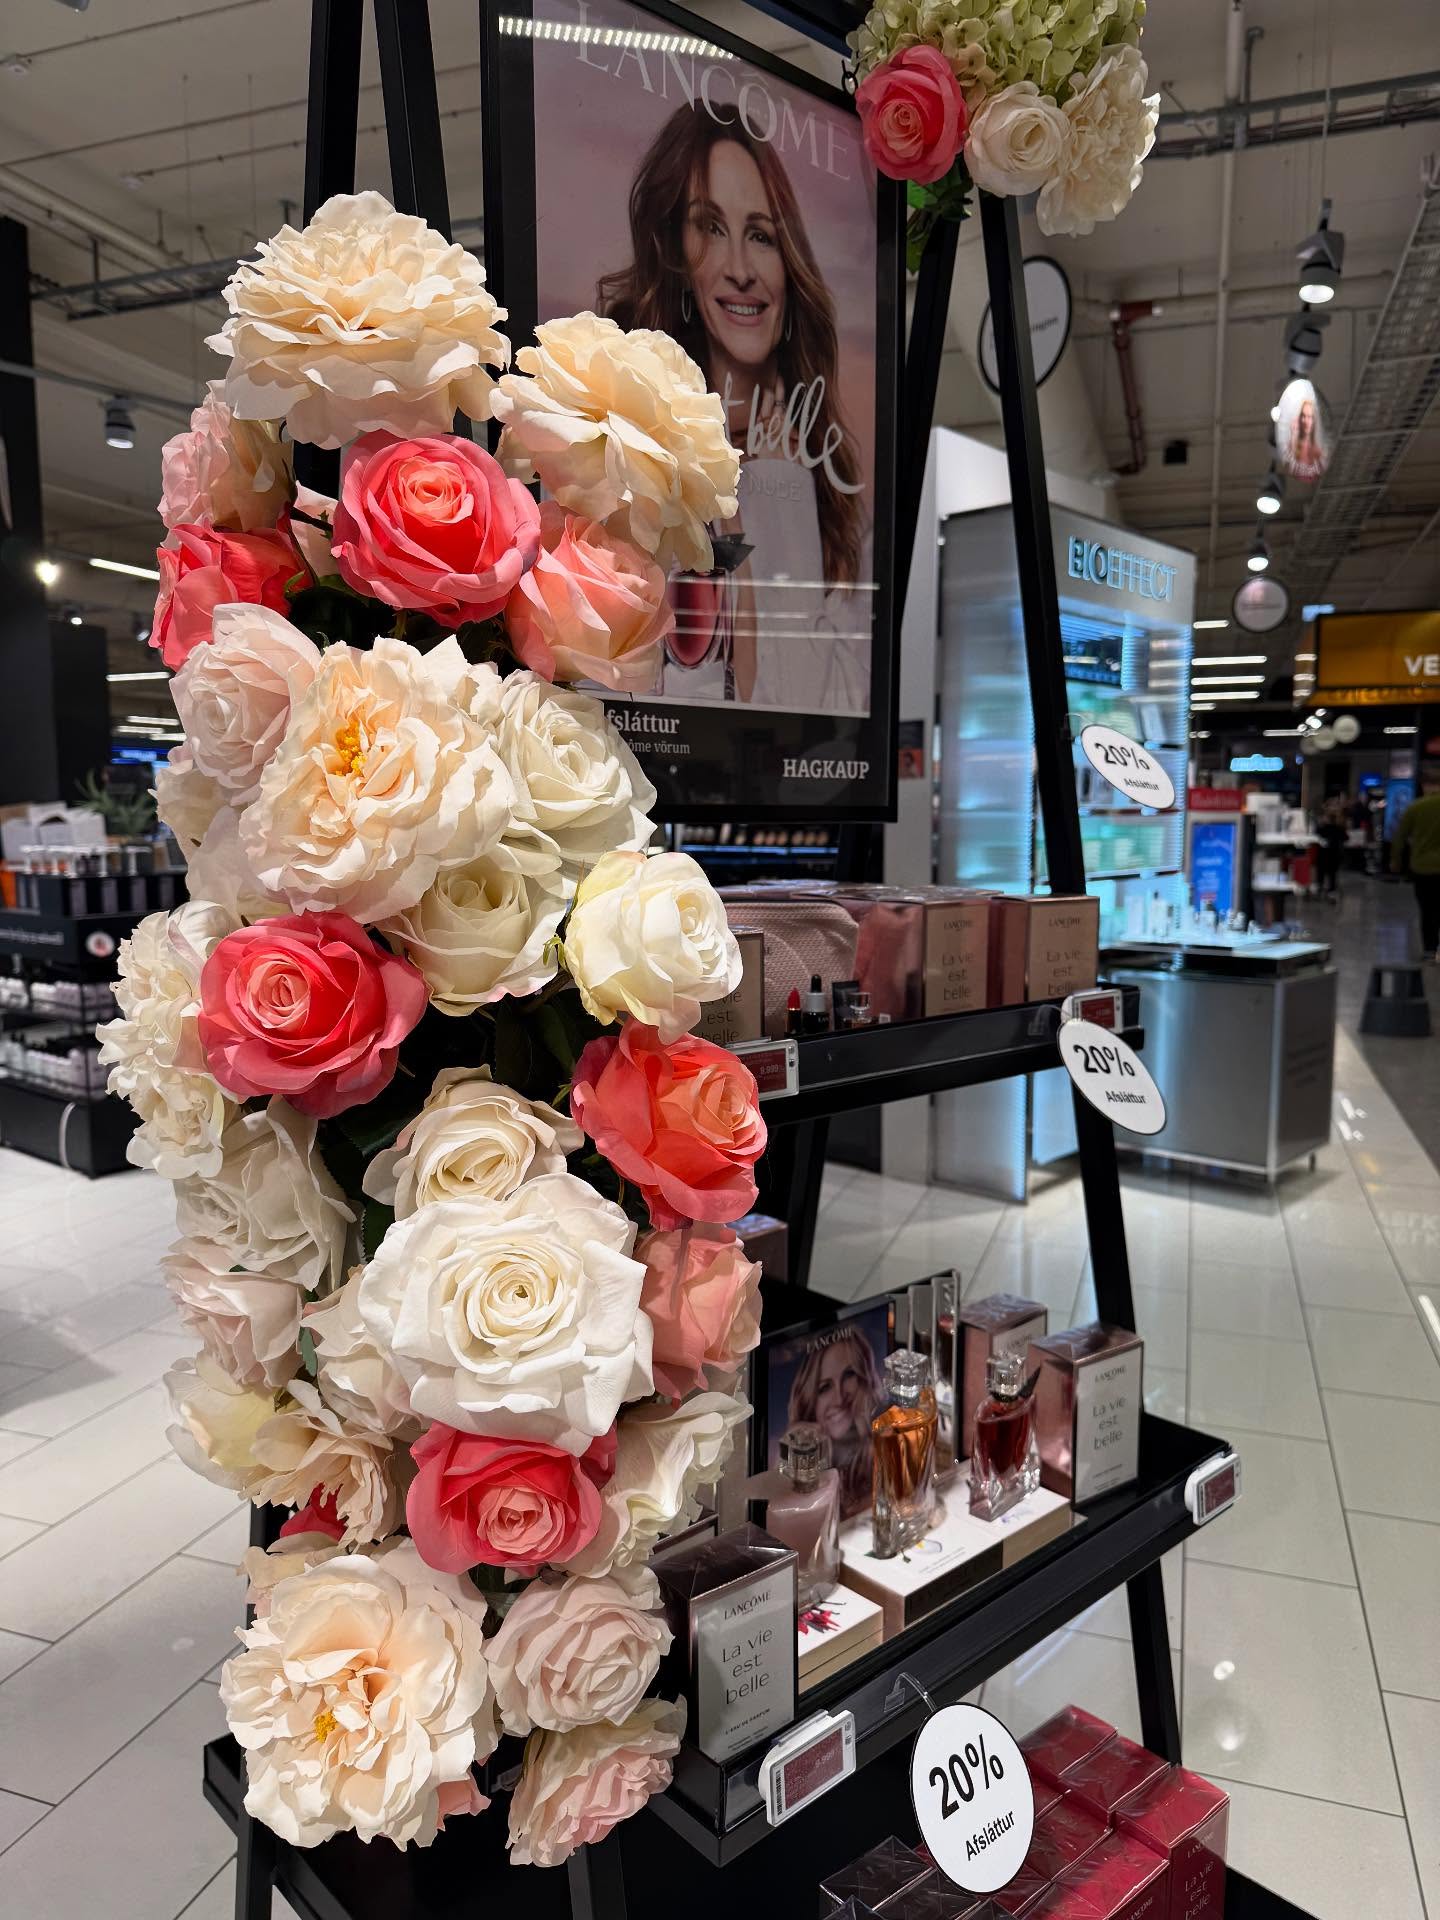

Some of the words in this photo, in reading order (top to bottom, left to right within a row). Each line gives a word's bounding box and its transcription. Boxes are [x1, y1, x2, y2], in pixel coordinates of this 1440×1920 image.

[576, 0, 851, 181] LANCÔME
[747, 375, 866, 494] belle
[1068, 535, 1178, 603] BIOEFFECT
[606, 709, 681, 735] fsláttur
[653, 739, 691, 755] vörum
[1094, 742, 1151, 771] 20%
[782, 758, 870, 780] HAGKAUP
[1123, 778, 1160, 791] Afsláttur
[707, 1010, 734, 1025] est
[1073, 1044, 1136, 1077] 20%
[1105, 1090, 1147, 1104] Afsláttur
[1091, 1402, 1107, 1418] La
[1108, 1396, 1126, 1411] vie
[1098, 1414, 1118, 1430] est
[1093, 1430, 1123, 1451] belle
[724, 1590, 772, 1621] LANCÔME
[721, 1644, 742, 1664] La
[747, 1628, 774, 1650] vie
[732, 1652, 763, 1678] est
[725, 1672, 770, 1705] belle
[928, 1733, 1005, 1821] 20%
[965, 1810, 1015, 1862] Afsláttur
[1185, 1877, 1197, 1893] La
[1185, 1894, 1211, 1920] belle
